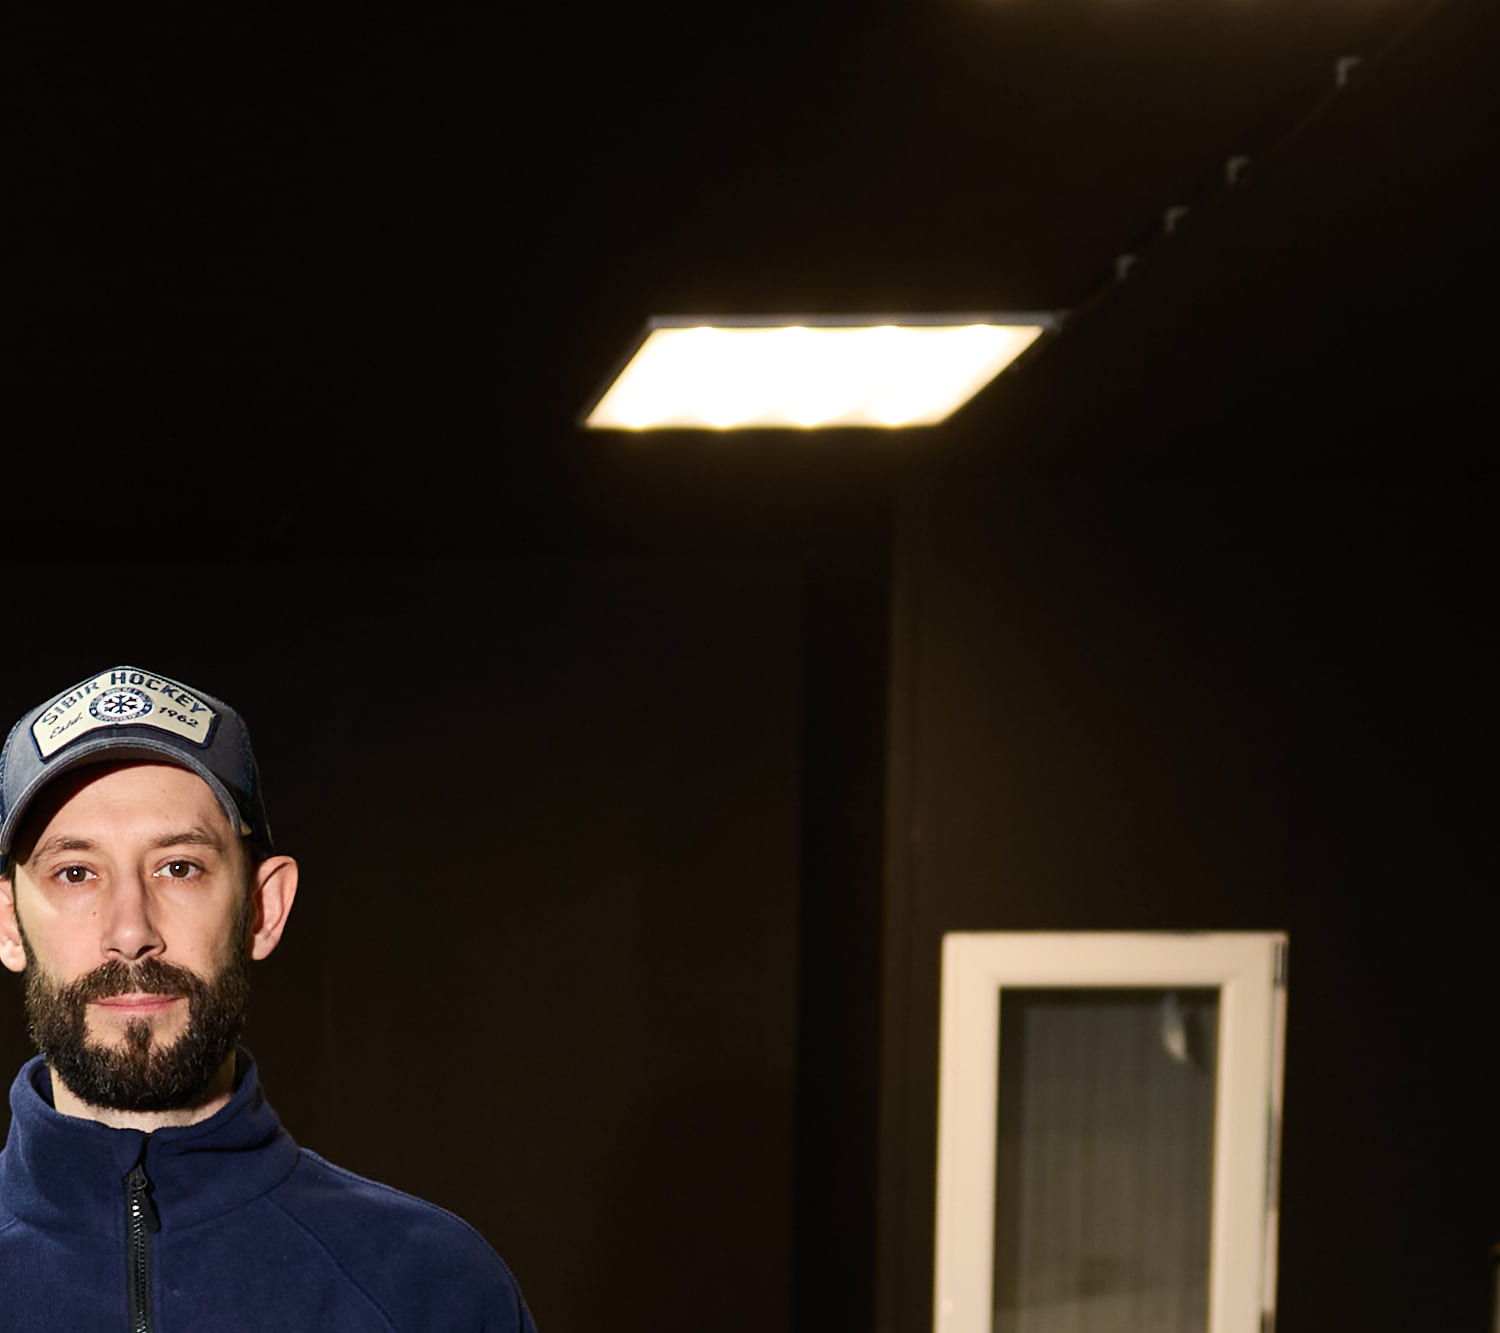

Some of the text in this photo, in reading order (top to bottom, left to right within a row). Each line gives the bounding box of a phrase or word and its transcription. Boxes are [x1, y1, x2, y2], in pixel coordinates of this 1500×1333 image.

[42, 681, 99, 725] SIBIR
[111, 671, 207, 714] HOCKEY
[158, 706, 199, 728] 1962
